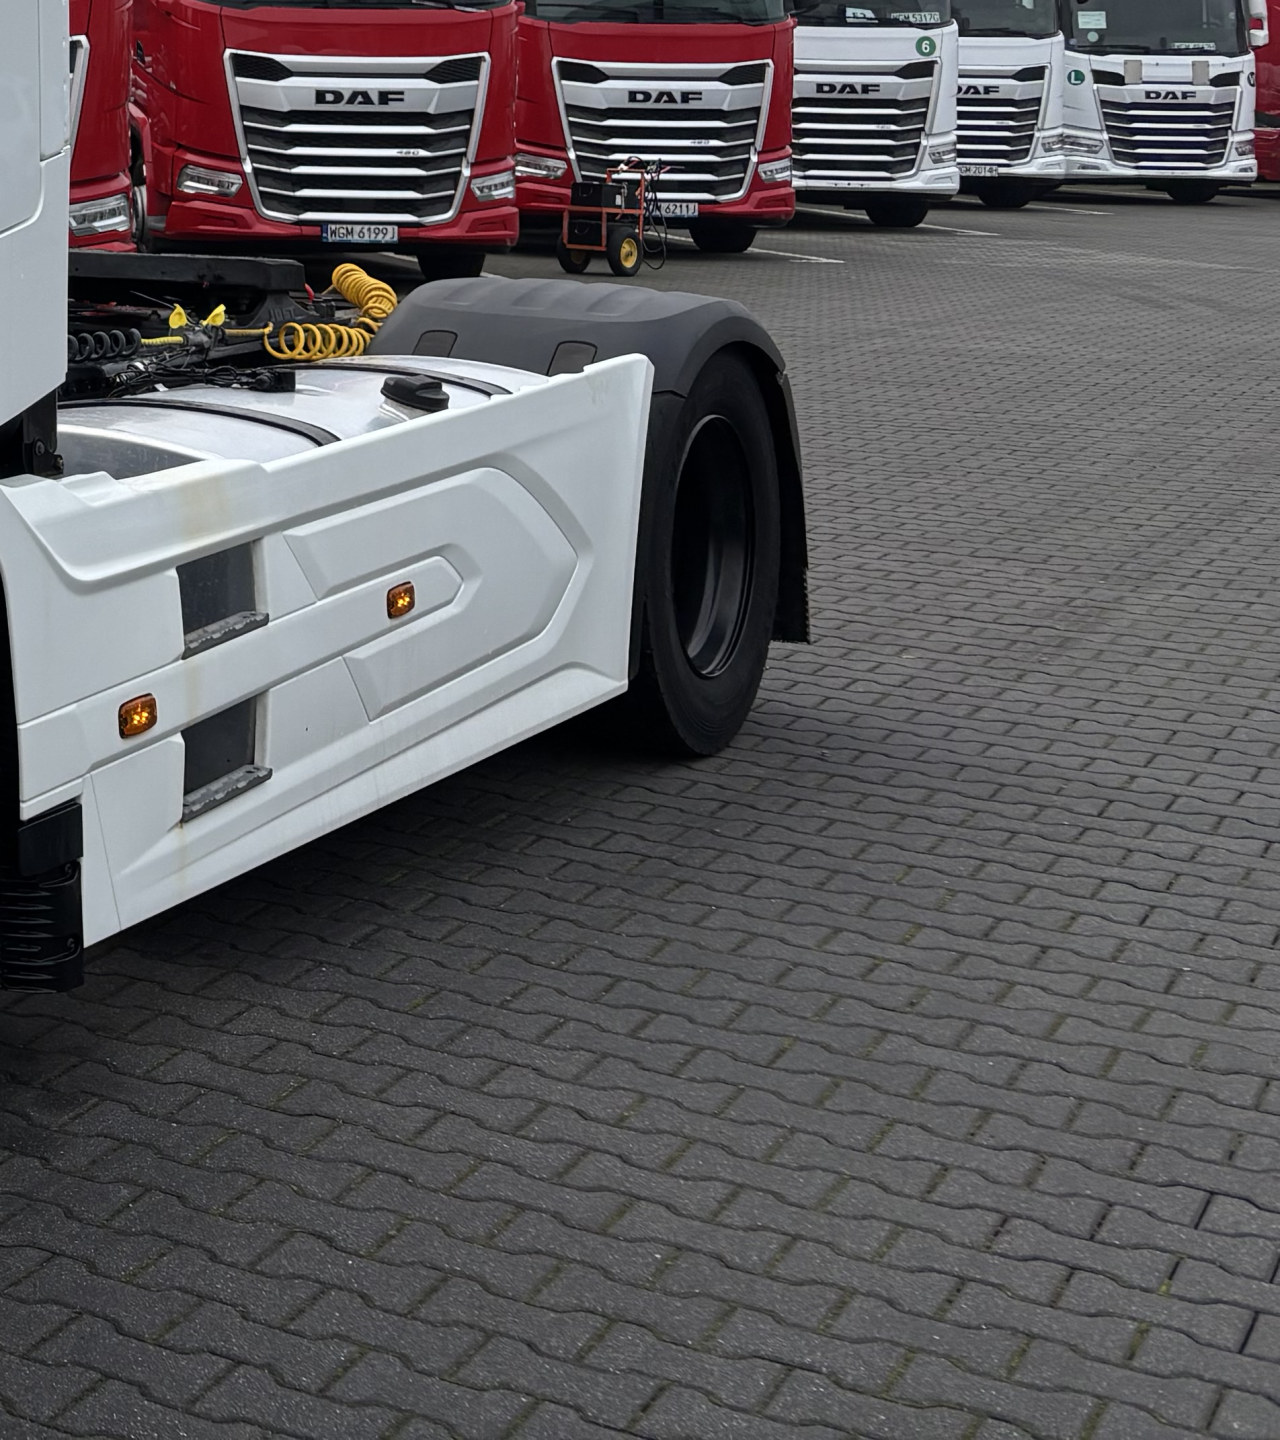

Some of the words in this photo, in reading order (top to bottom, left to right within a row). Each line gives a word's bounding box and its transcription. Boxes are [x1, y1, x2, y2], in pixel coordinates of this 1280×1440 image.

[921, 40, 931, 53] 6
[1070, 71, 1079, 84] L
[816, 83, 880, 94] DAF
[1144, 90, 1197, 100] DAF
[315, 89, 405, 106] DAF
[628, 90, 703, 104] DAF
[329, 225, 354, 239] WGM
[357, 226, 396, 240] 6199J
